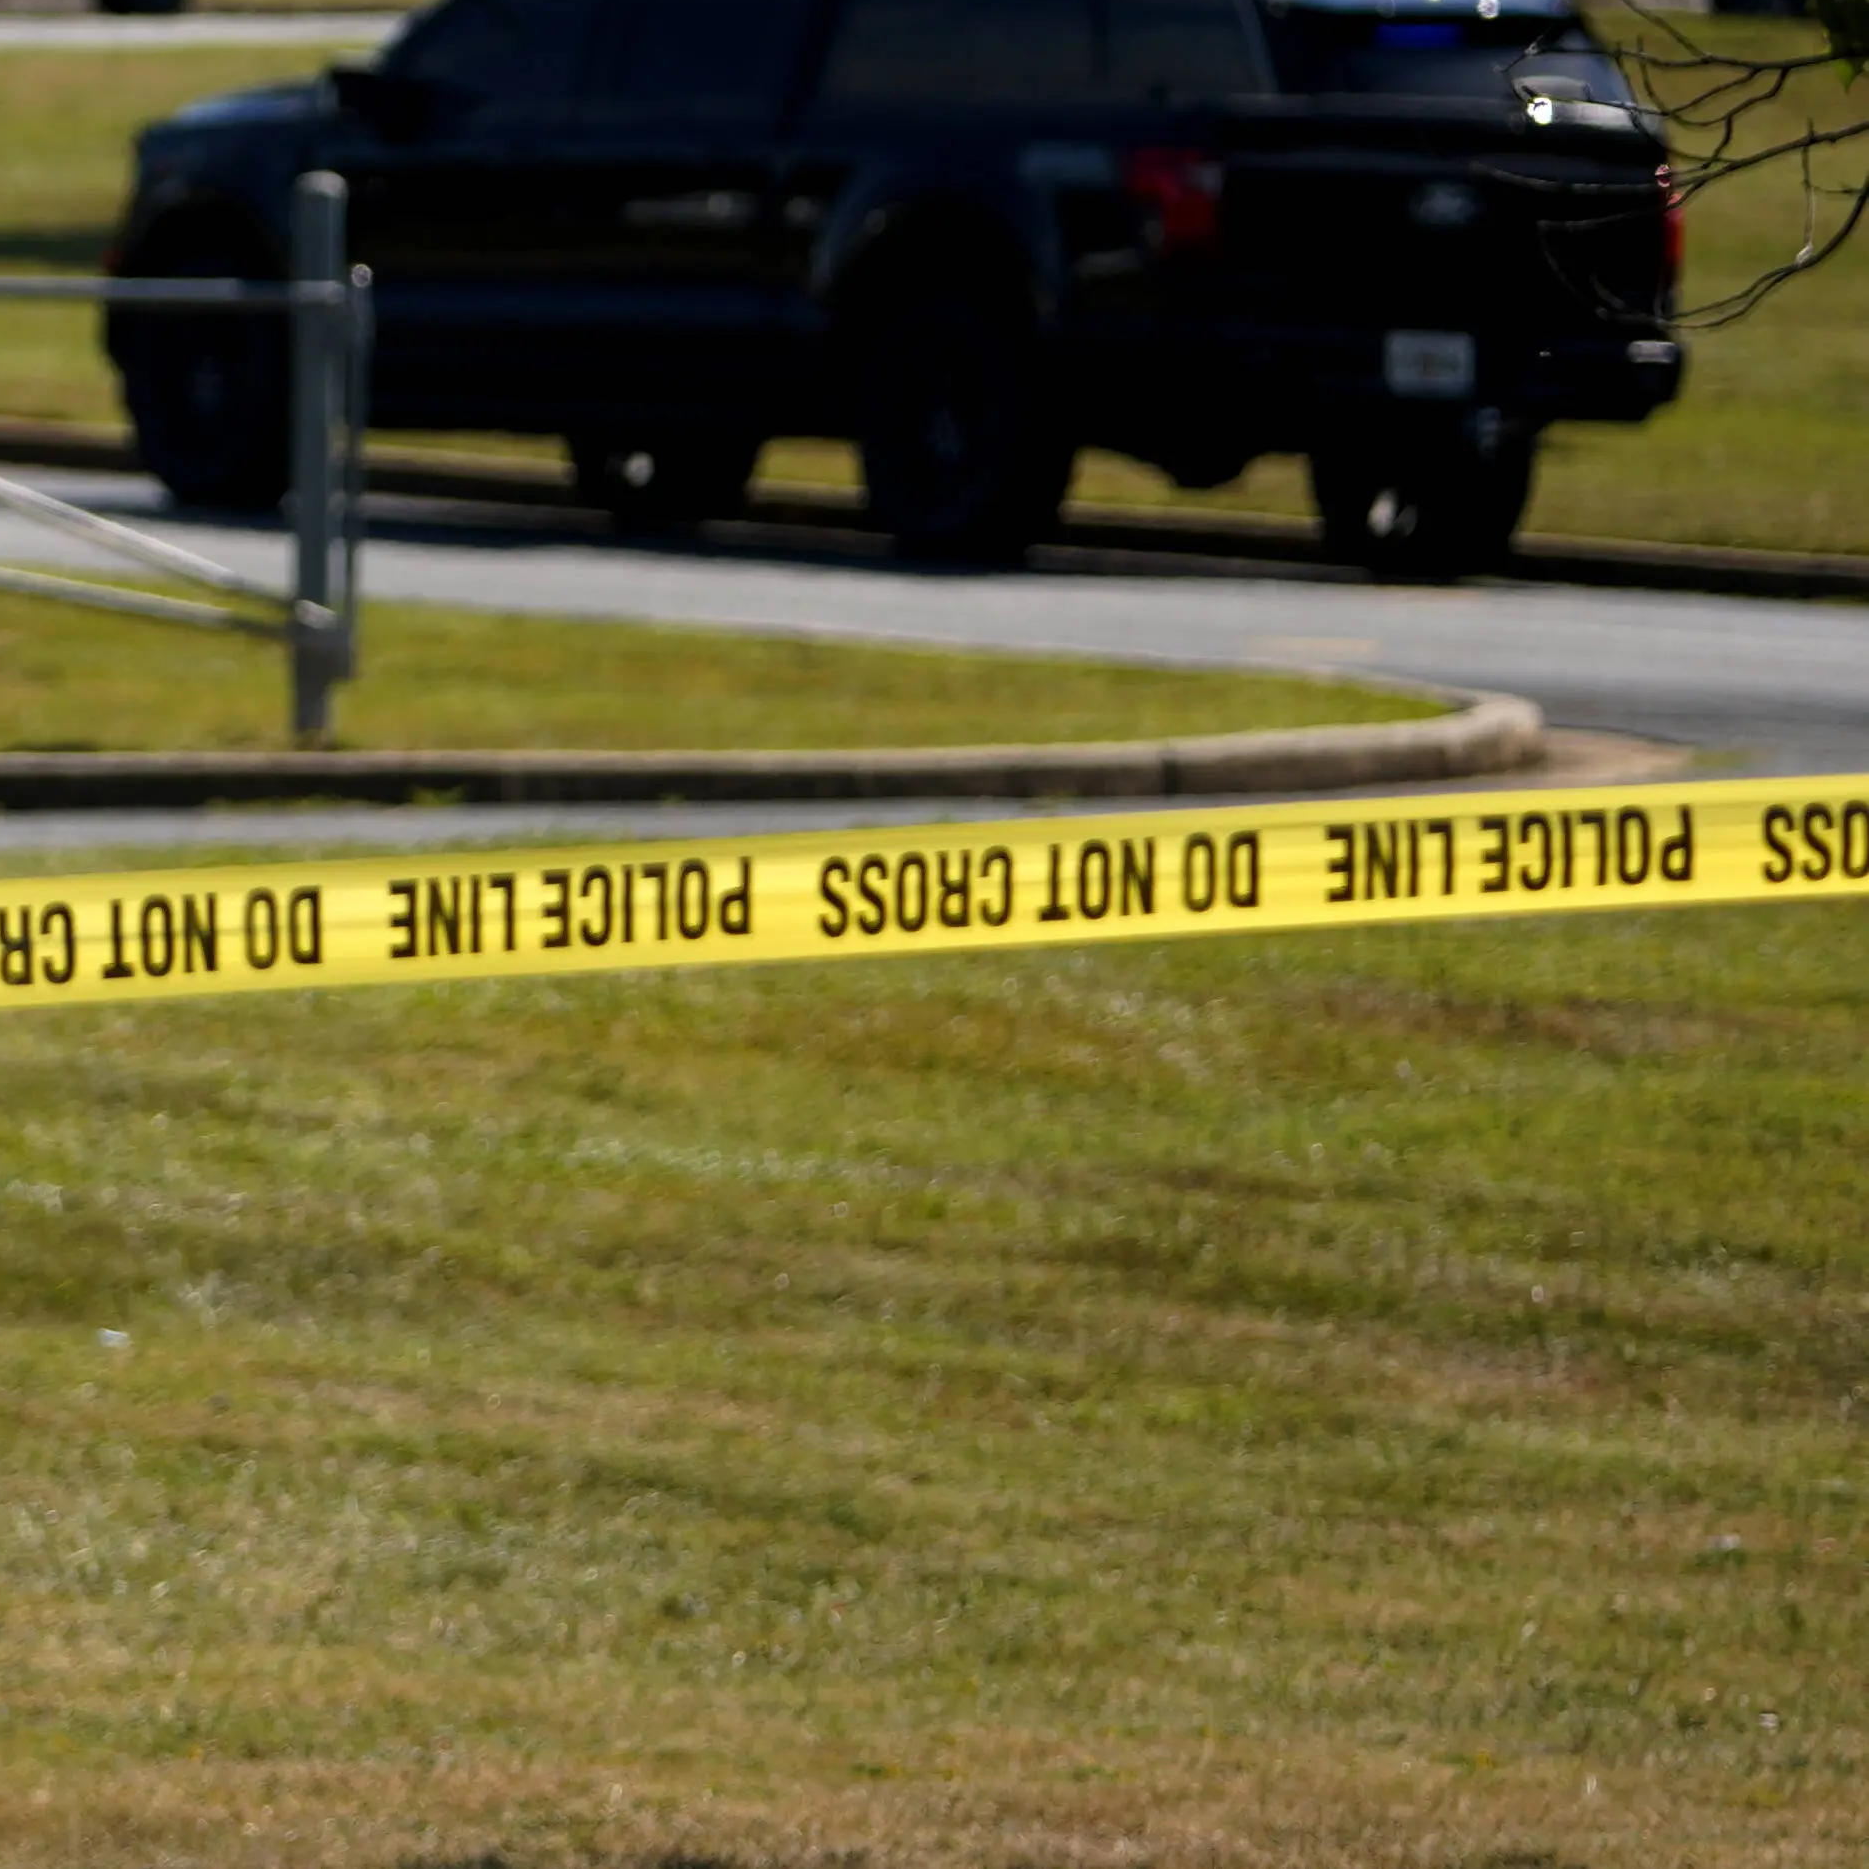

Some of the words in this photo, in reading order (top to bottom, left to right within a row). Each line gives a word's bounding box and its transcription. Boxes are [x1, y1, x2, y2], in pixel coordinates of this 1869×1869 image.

[1039, 840, 1154, 922] NOT
[1186, 831, 1259, 912] DO
[1327, 819, 1454, 903] LINE
[1481, 806, 1693, 894] POLICE
[1763, 801, 1869, 883] OSS
[249, 888, 321, 971] DO
[390, 875, 515, 960] LINE
[543, 859, 750, 949] POLICE
[820, 849, 1012, 939] CROSS
[103, 896, 217, 980] NOT
